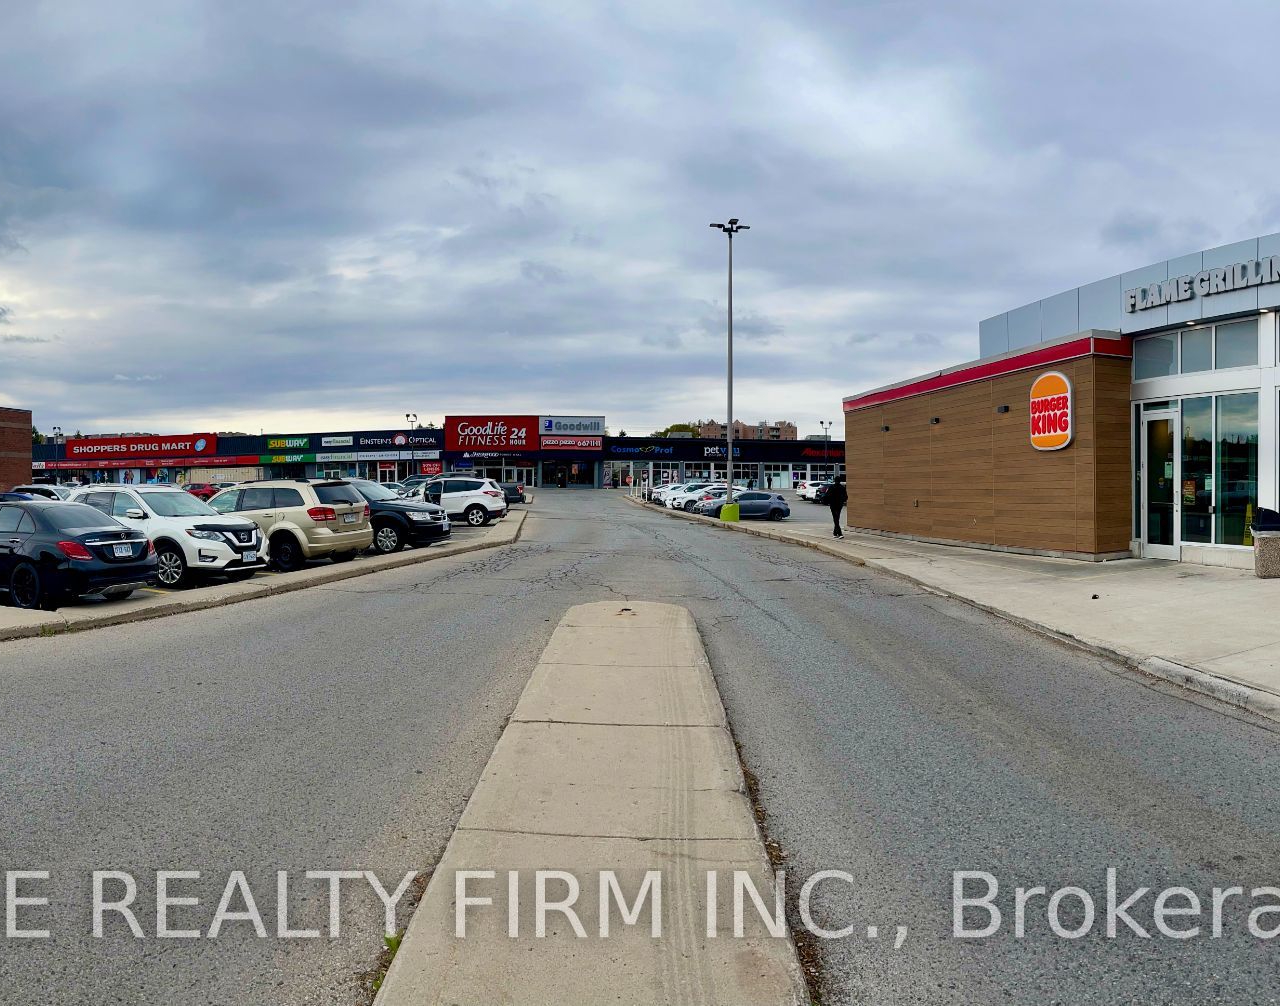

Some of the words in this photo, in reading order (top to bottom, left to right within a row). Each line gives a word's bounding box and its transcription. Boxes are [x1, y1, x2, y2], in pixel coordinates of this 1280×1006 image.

[1125, 275, 1194, 313] FLAME
[1031, 396, 1068, 414] BURGER
[555, 422, 600, 431] Goodwill
[1031, 411, 1069, 435] KING
[510, 428, 526, 438] 24
[269, 438, 307, 448] SUBWAY
[458, 436, 507, 445] FITNESS
[73, 444, 127, 453] SHOPPERS
[130, 443, 159, 451] DRUG
[161, 442, 191, 450] MART
[611, 445, 639, 453] Cosmo
[655, 446, 673, 454] Prof
[271, 454, 303, 463] SUBWAY
